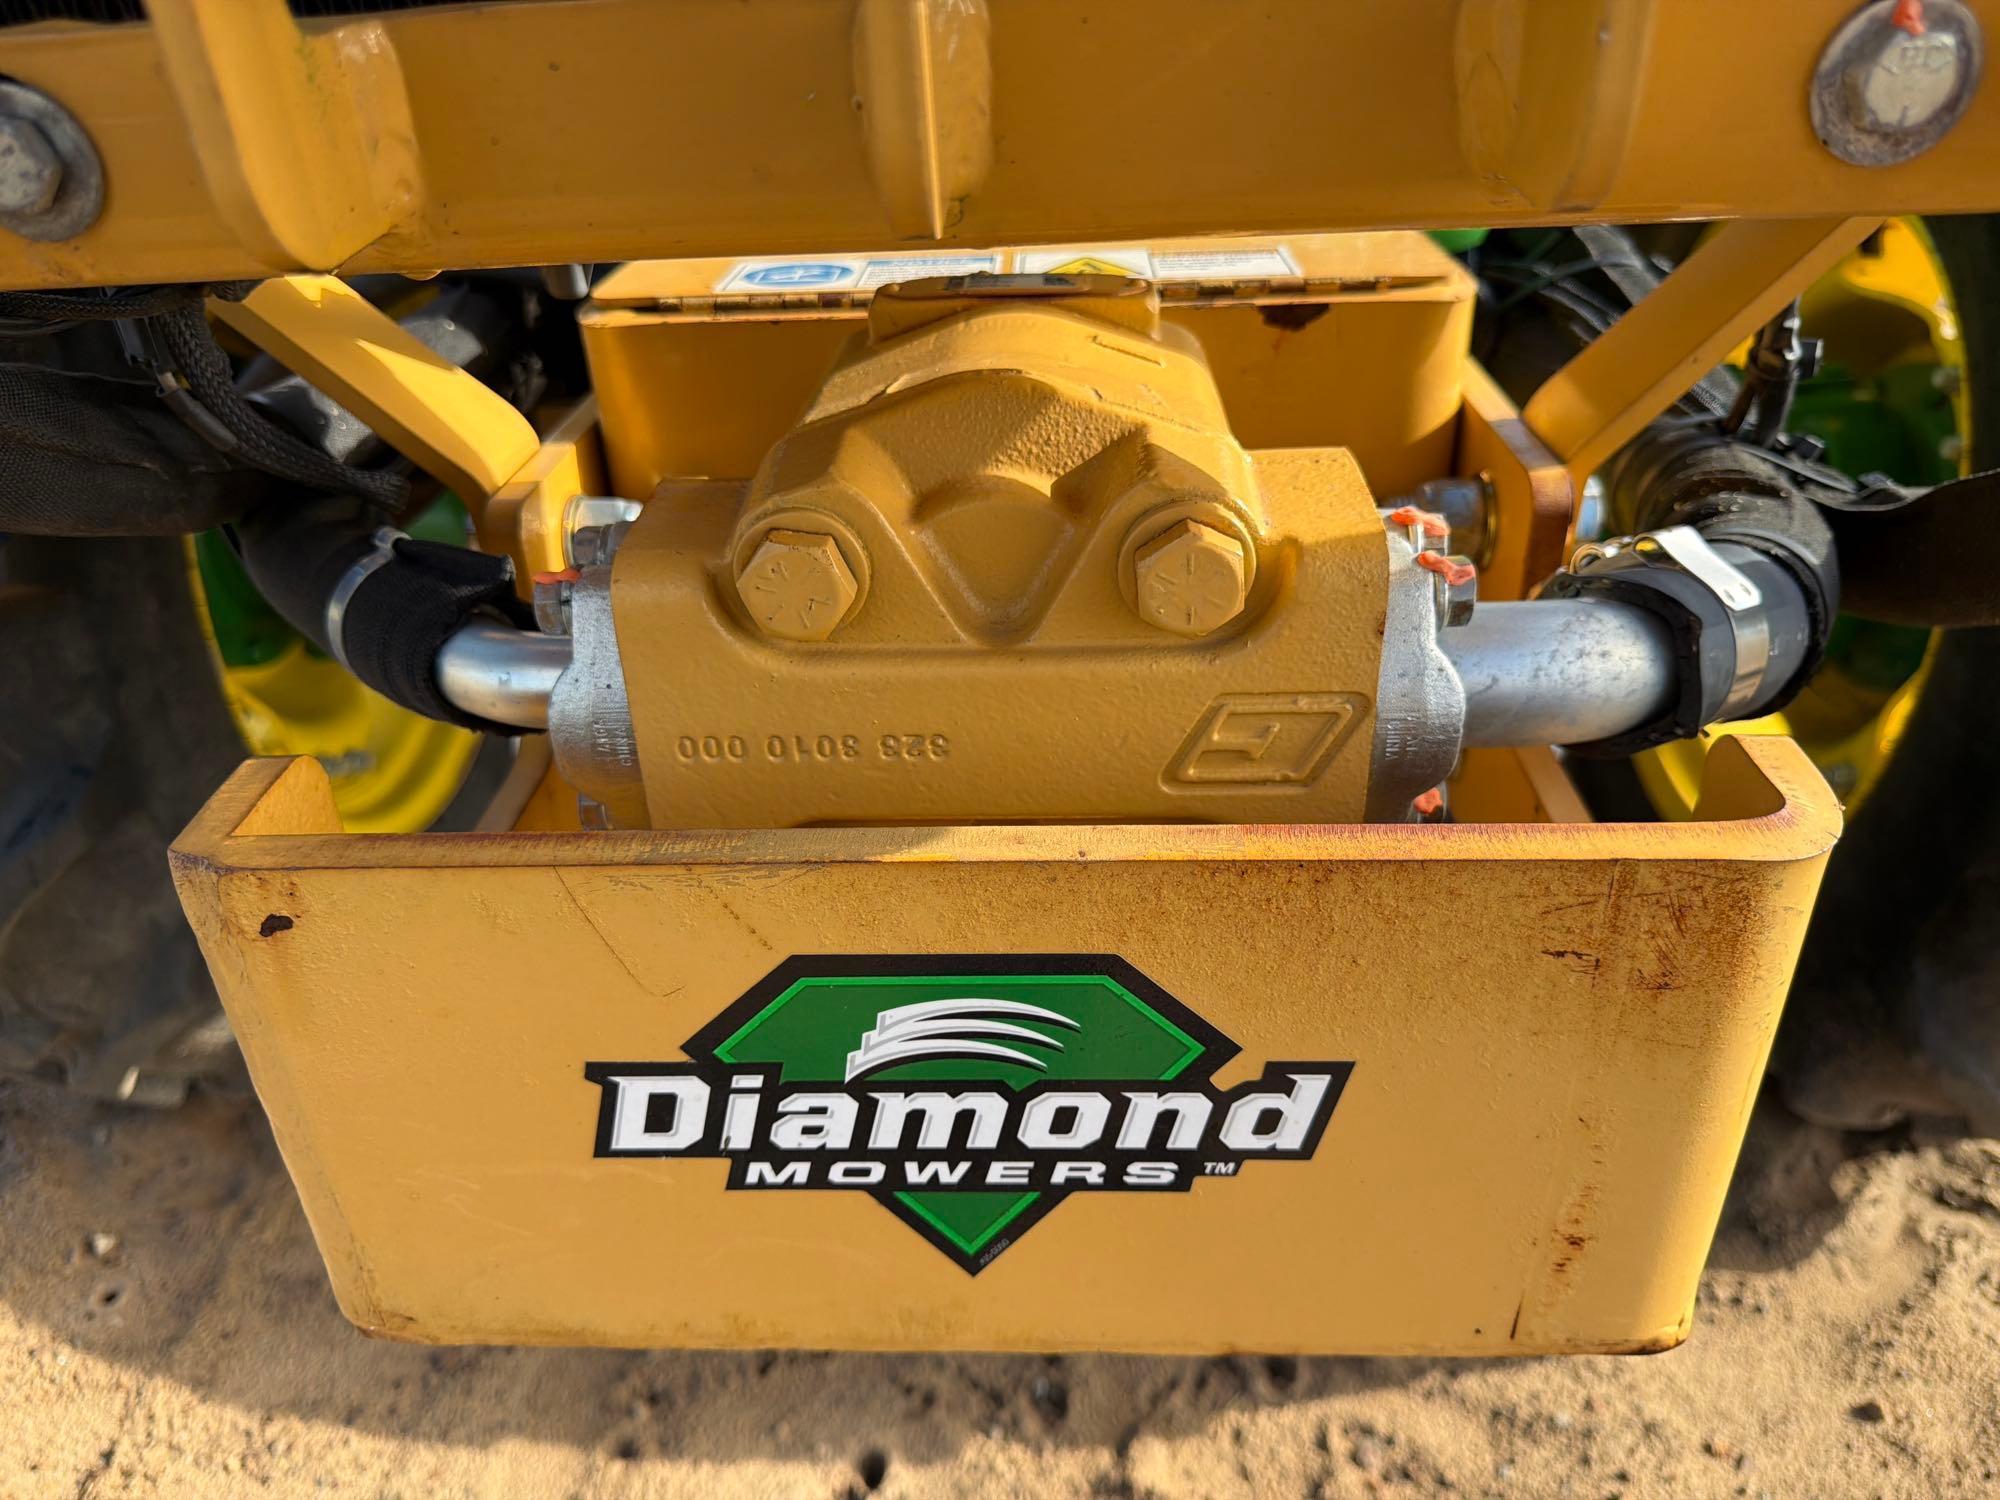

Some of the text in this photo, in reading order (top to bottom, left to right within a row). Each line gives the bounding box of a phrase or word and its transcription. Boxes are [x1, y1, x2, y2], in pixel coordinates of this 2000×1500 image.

[677, 733, 948, 763] 323 3010 000
[607, 1073, 1332, 1150] Diamond
[744, 1161, 1180, 1185] MOWERS
